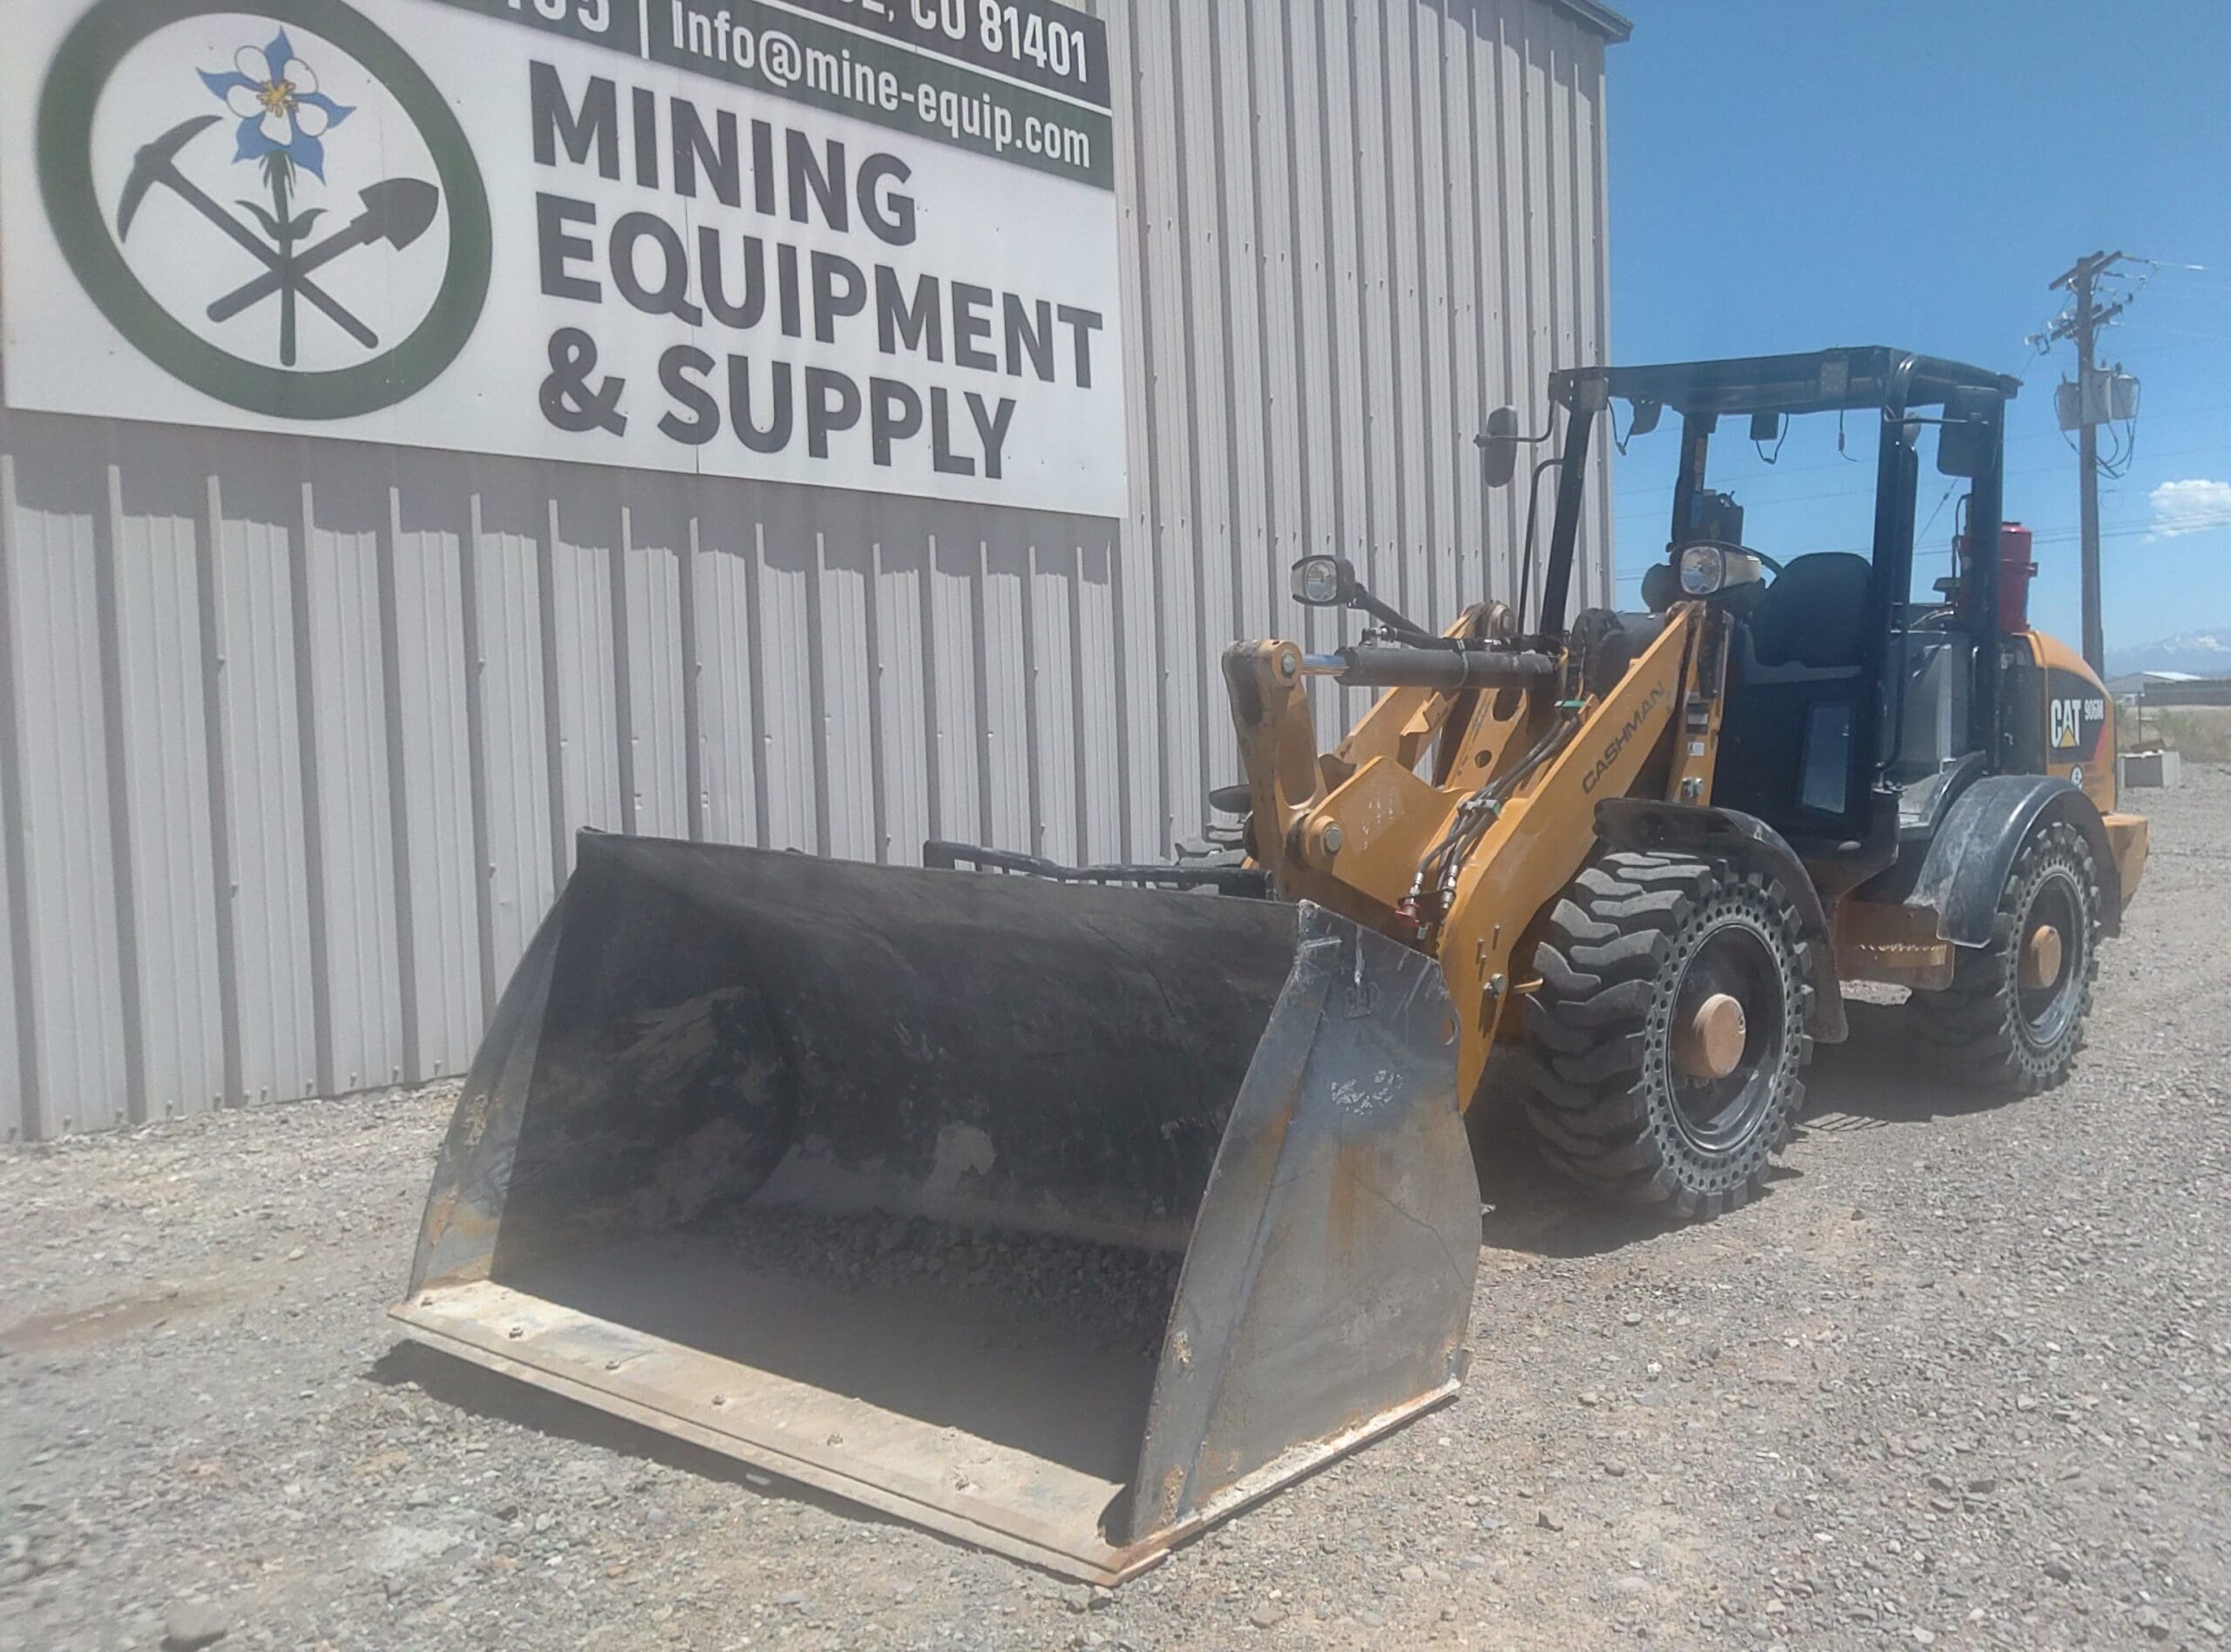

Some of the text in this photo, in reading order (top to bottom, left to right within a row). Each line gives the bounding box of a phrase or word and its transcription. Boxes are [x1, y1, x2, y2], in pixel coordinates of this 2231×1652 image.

[672, 0, 1091, 169] Info@mine-equip.com
[980, 0, 1088, 83] 81401
[529, 58, 917, 246] MINING
[535, 191, 1103, 389] EQUIPMENT
[539, 326, 1017, 479] & SUPPLY
[1582, 680, 1665, 795] CASHMAN
[2051, 699, 2082, 748] CAT
